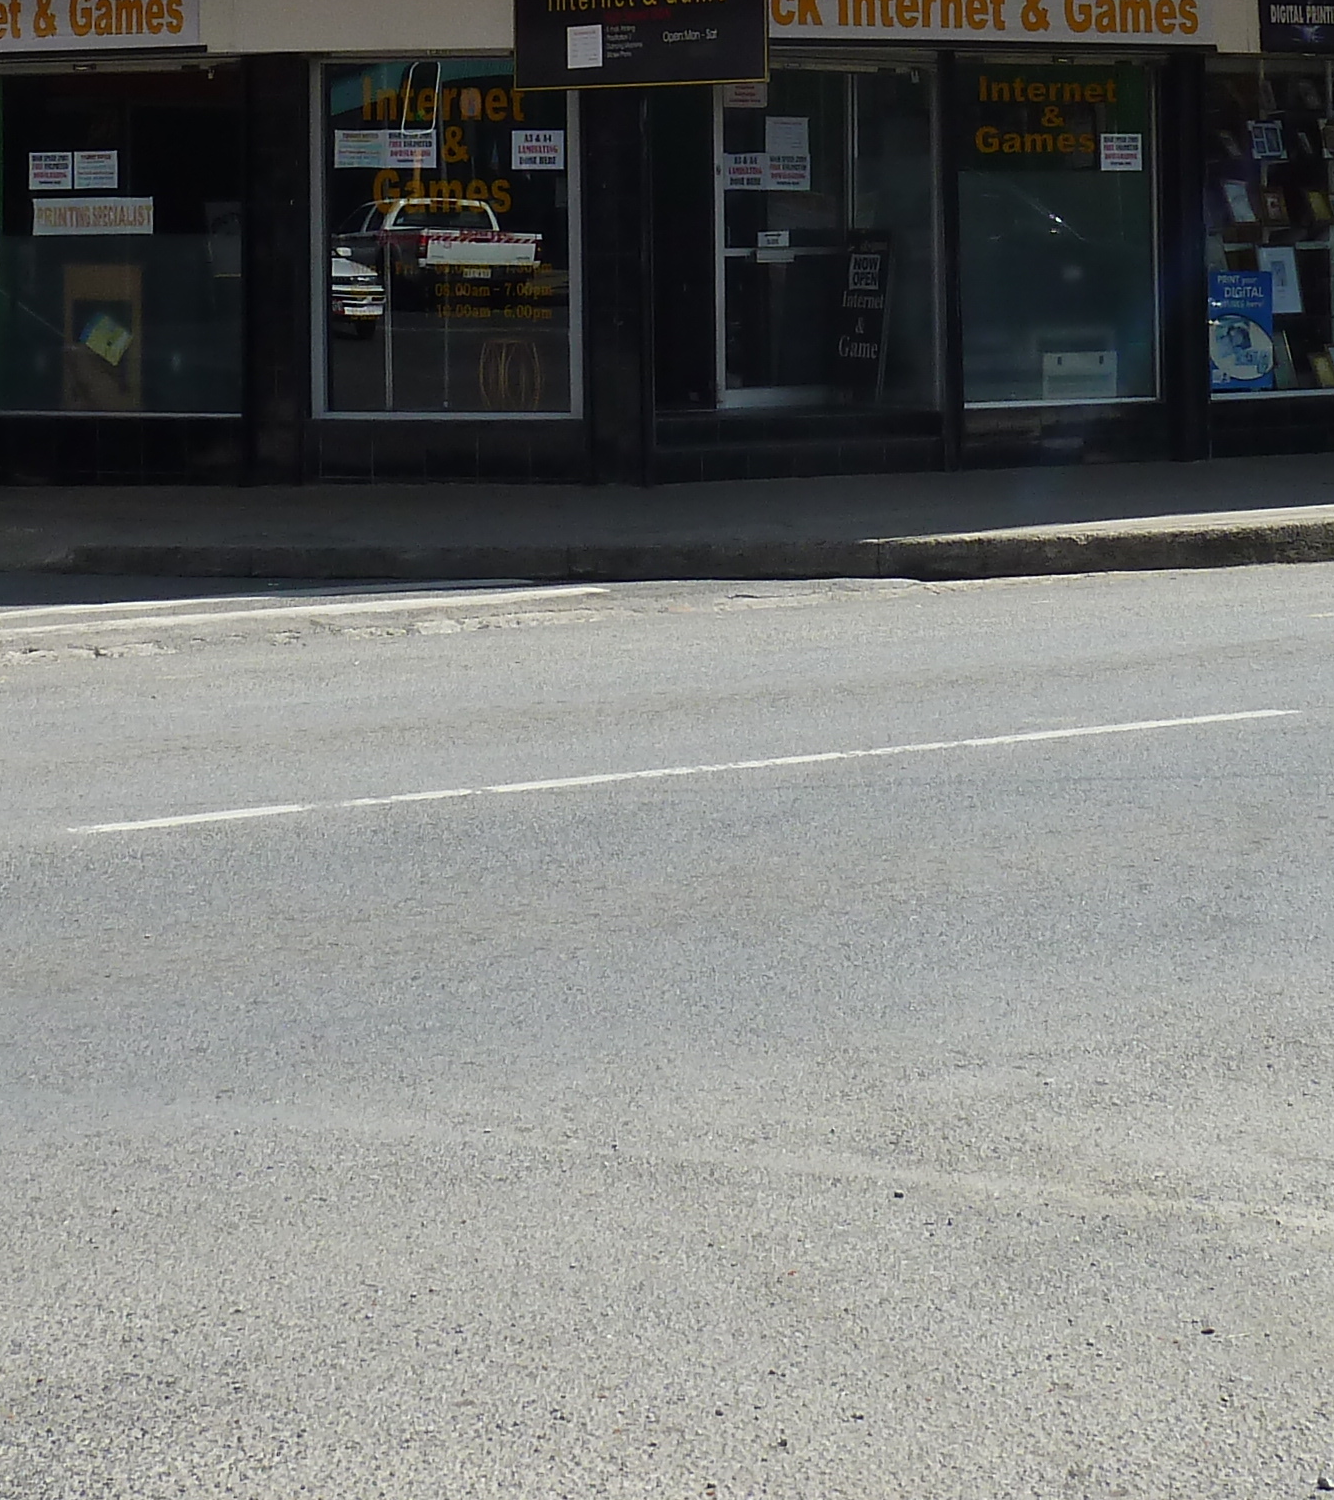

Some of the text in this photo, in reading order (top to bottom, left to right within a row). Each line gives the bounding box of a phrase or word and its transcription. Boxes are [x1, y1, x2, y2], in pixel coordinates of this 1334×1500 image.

[1270, 4, 1305, 24] DIGITAL
[361, 74, 526, 122] Internet
[978, 75, 1117, 103] Internet
[1041, 104, 1065, 128] &
[441, 125, 470, 164] &
[974, 124, 1096, 154] Games
[372, 168, 513, 215] Games
[854, 257, 881, 271] NOW
[853, 271, 877, 286] OPEN
[841, 290, 884, 310] Internet
[1224, 286, 1265, 299] DIGITAL
[855, 316, 865, 335] &
[838, 335, 879, 359] Game
